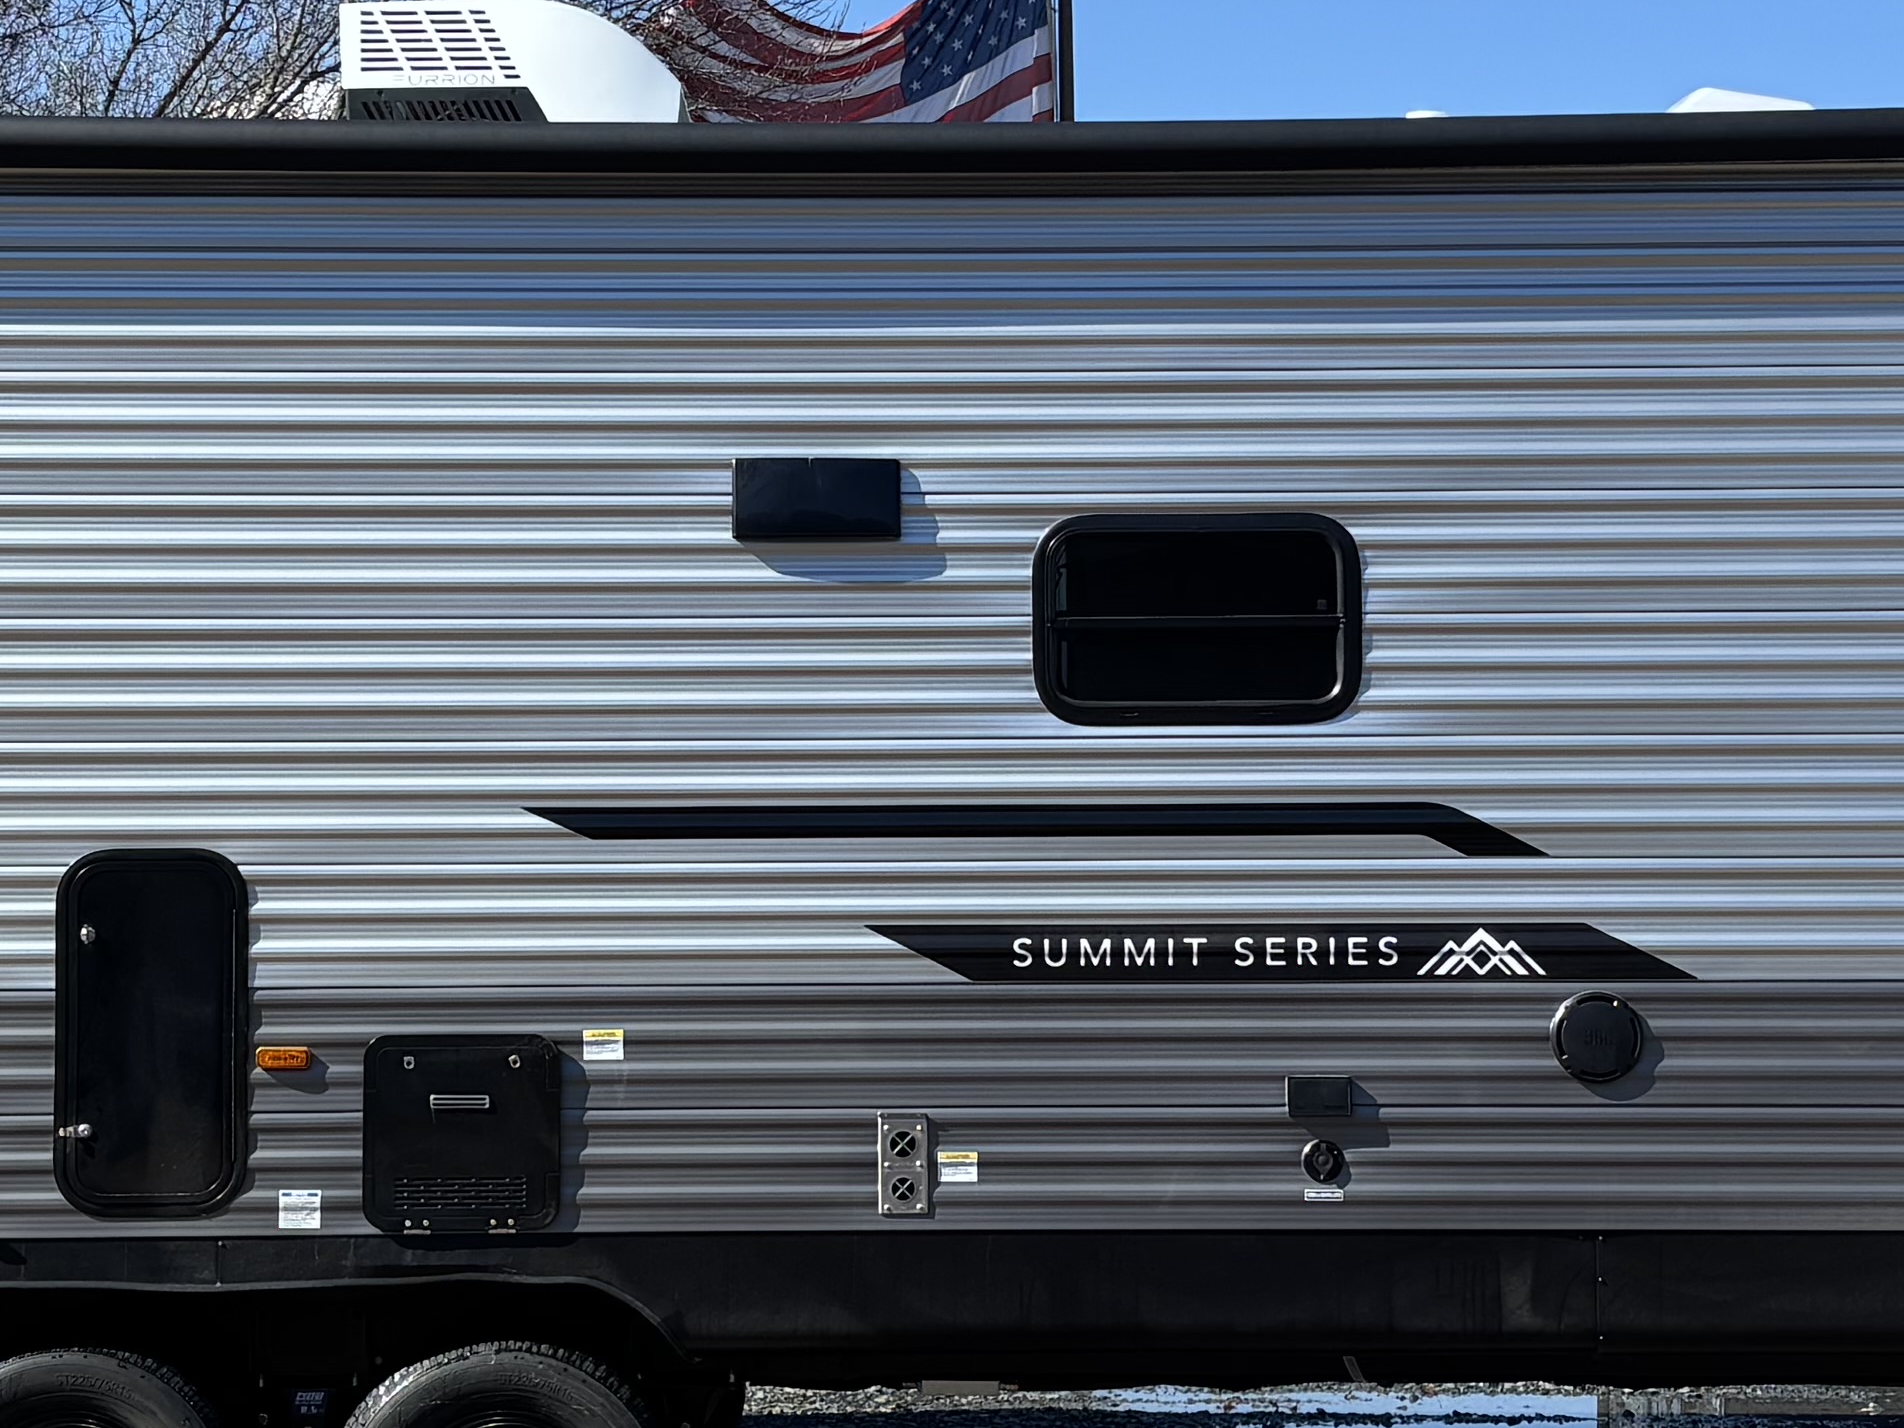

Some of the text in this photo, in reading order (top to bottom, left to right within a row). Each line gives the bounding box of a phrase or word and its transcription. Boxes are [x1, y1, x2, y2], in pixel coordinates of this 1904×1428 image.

[391, 73, 496, 86] FURRION
[1011, 935, 1399, 968] SUMMIT SERIES
